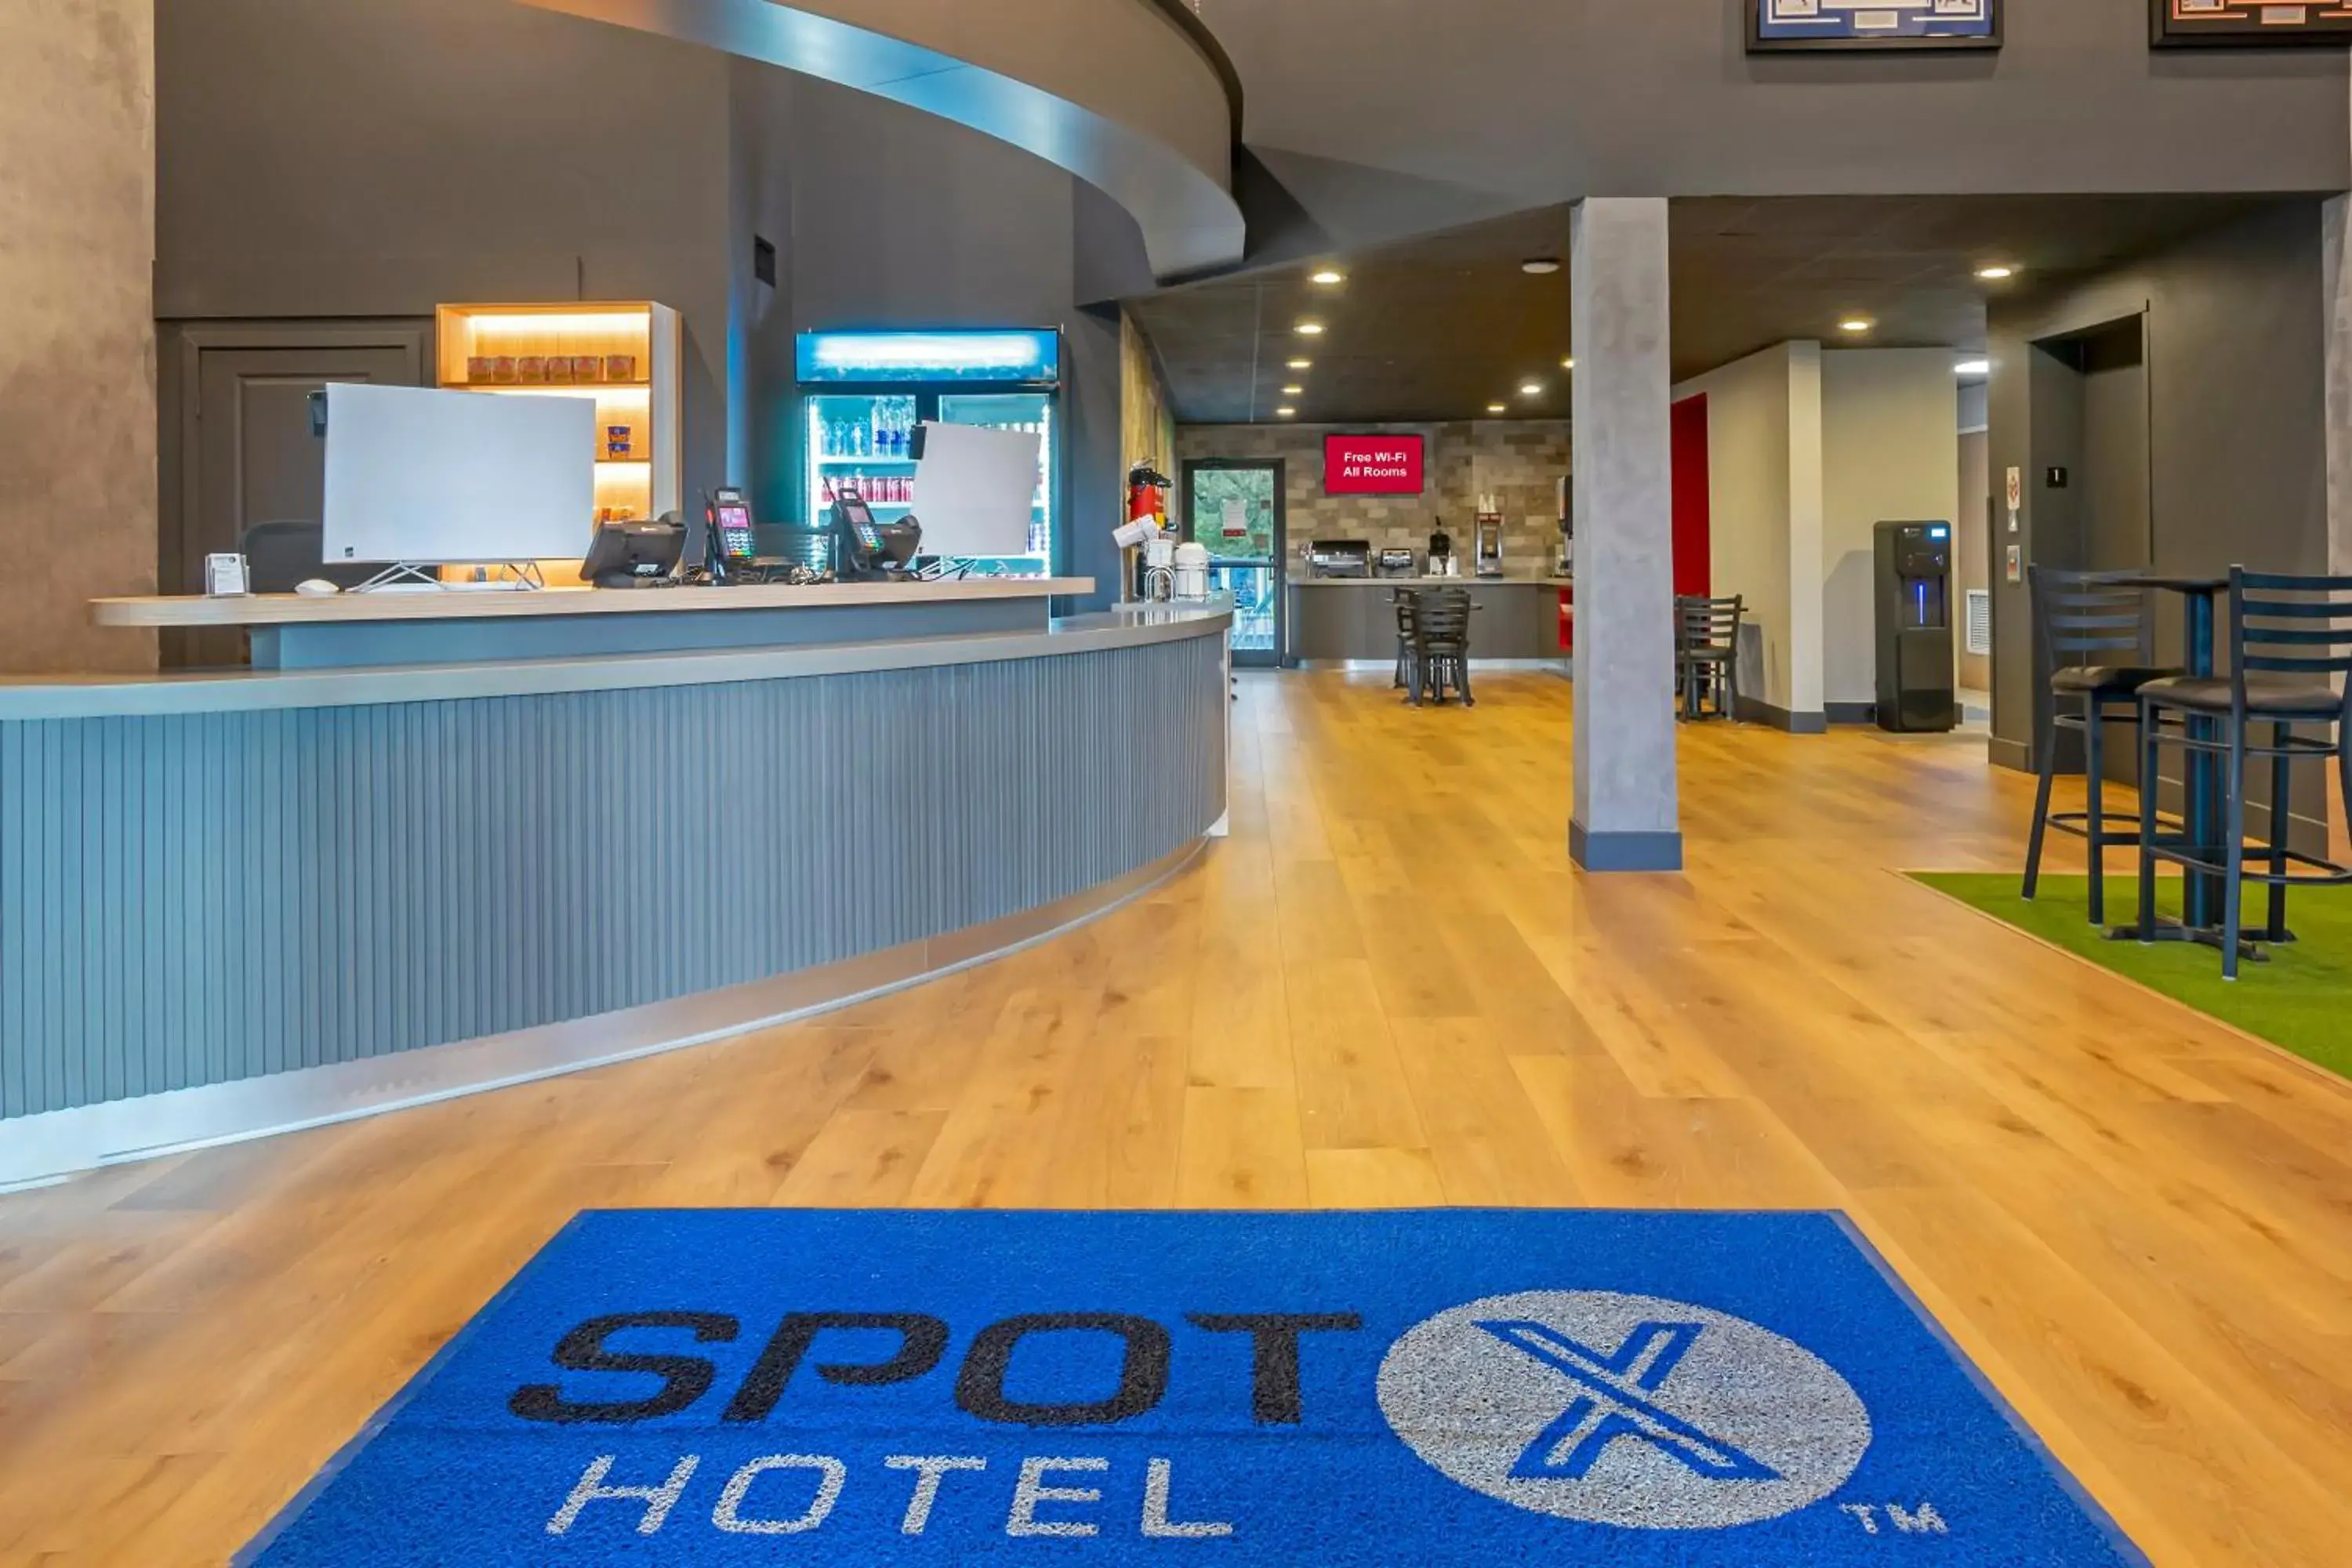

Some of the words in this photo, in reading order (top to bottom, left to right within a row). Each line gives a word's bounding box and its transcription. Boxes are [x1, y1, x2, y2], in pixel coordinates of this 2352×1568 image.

[1343, 466, 1360, 477] All
[1363, 466, 1407, 477] Rooms
[1344, 452, 1371, 462] Free
[1374, 452, 1407, 462] Wi-Fi
[510, 1312, 1361, 1425] SPOT
[546, 1454, 1234, 1537] HOTEL
[1838, 1501, 1951, 1534] TM
